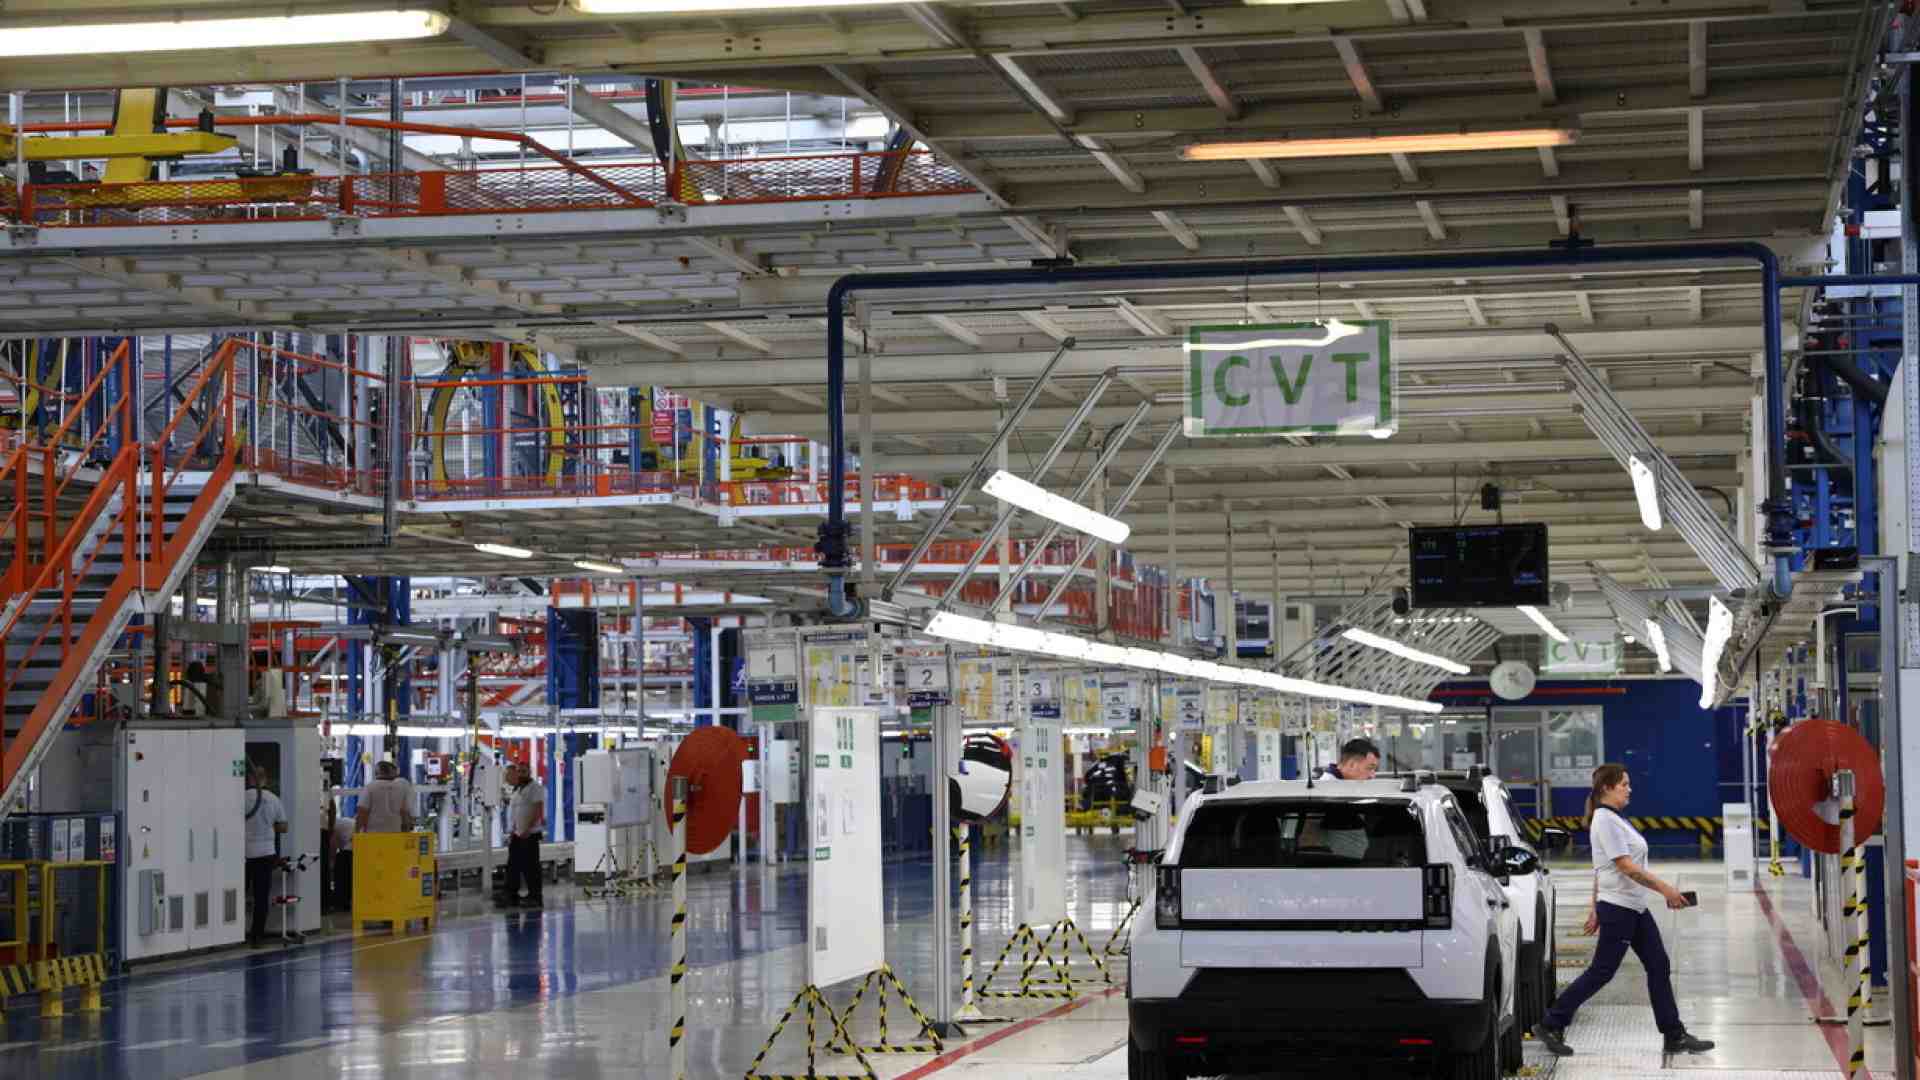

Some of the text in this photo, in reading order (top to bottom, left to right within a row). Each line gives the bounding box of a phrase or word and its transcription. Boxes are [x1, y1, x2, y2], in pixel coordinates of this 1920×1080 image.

[1213, 352, 1371, 408] CVT
[1551, 640, 1612, 662] CVT
[766, 653, 777, 674] 1
[922, 668, 934, 685] 2
[1032, 682, 1042, 696] 3
